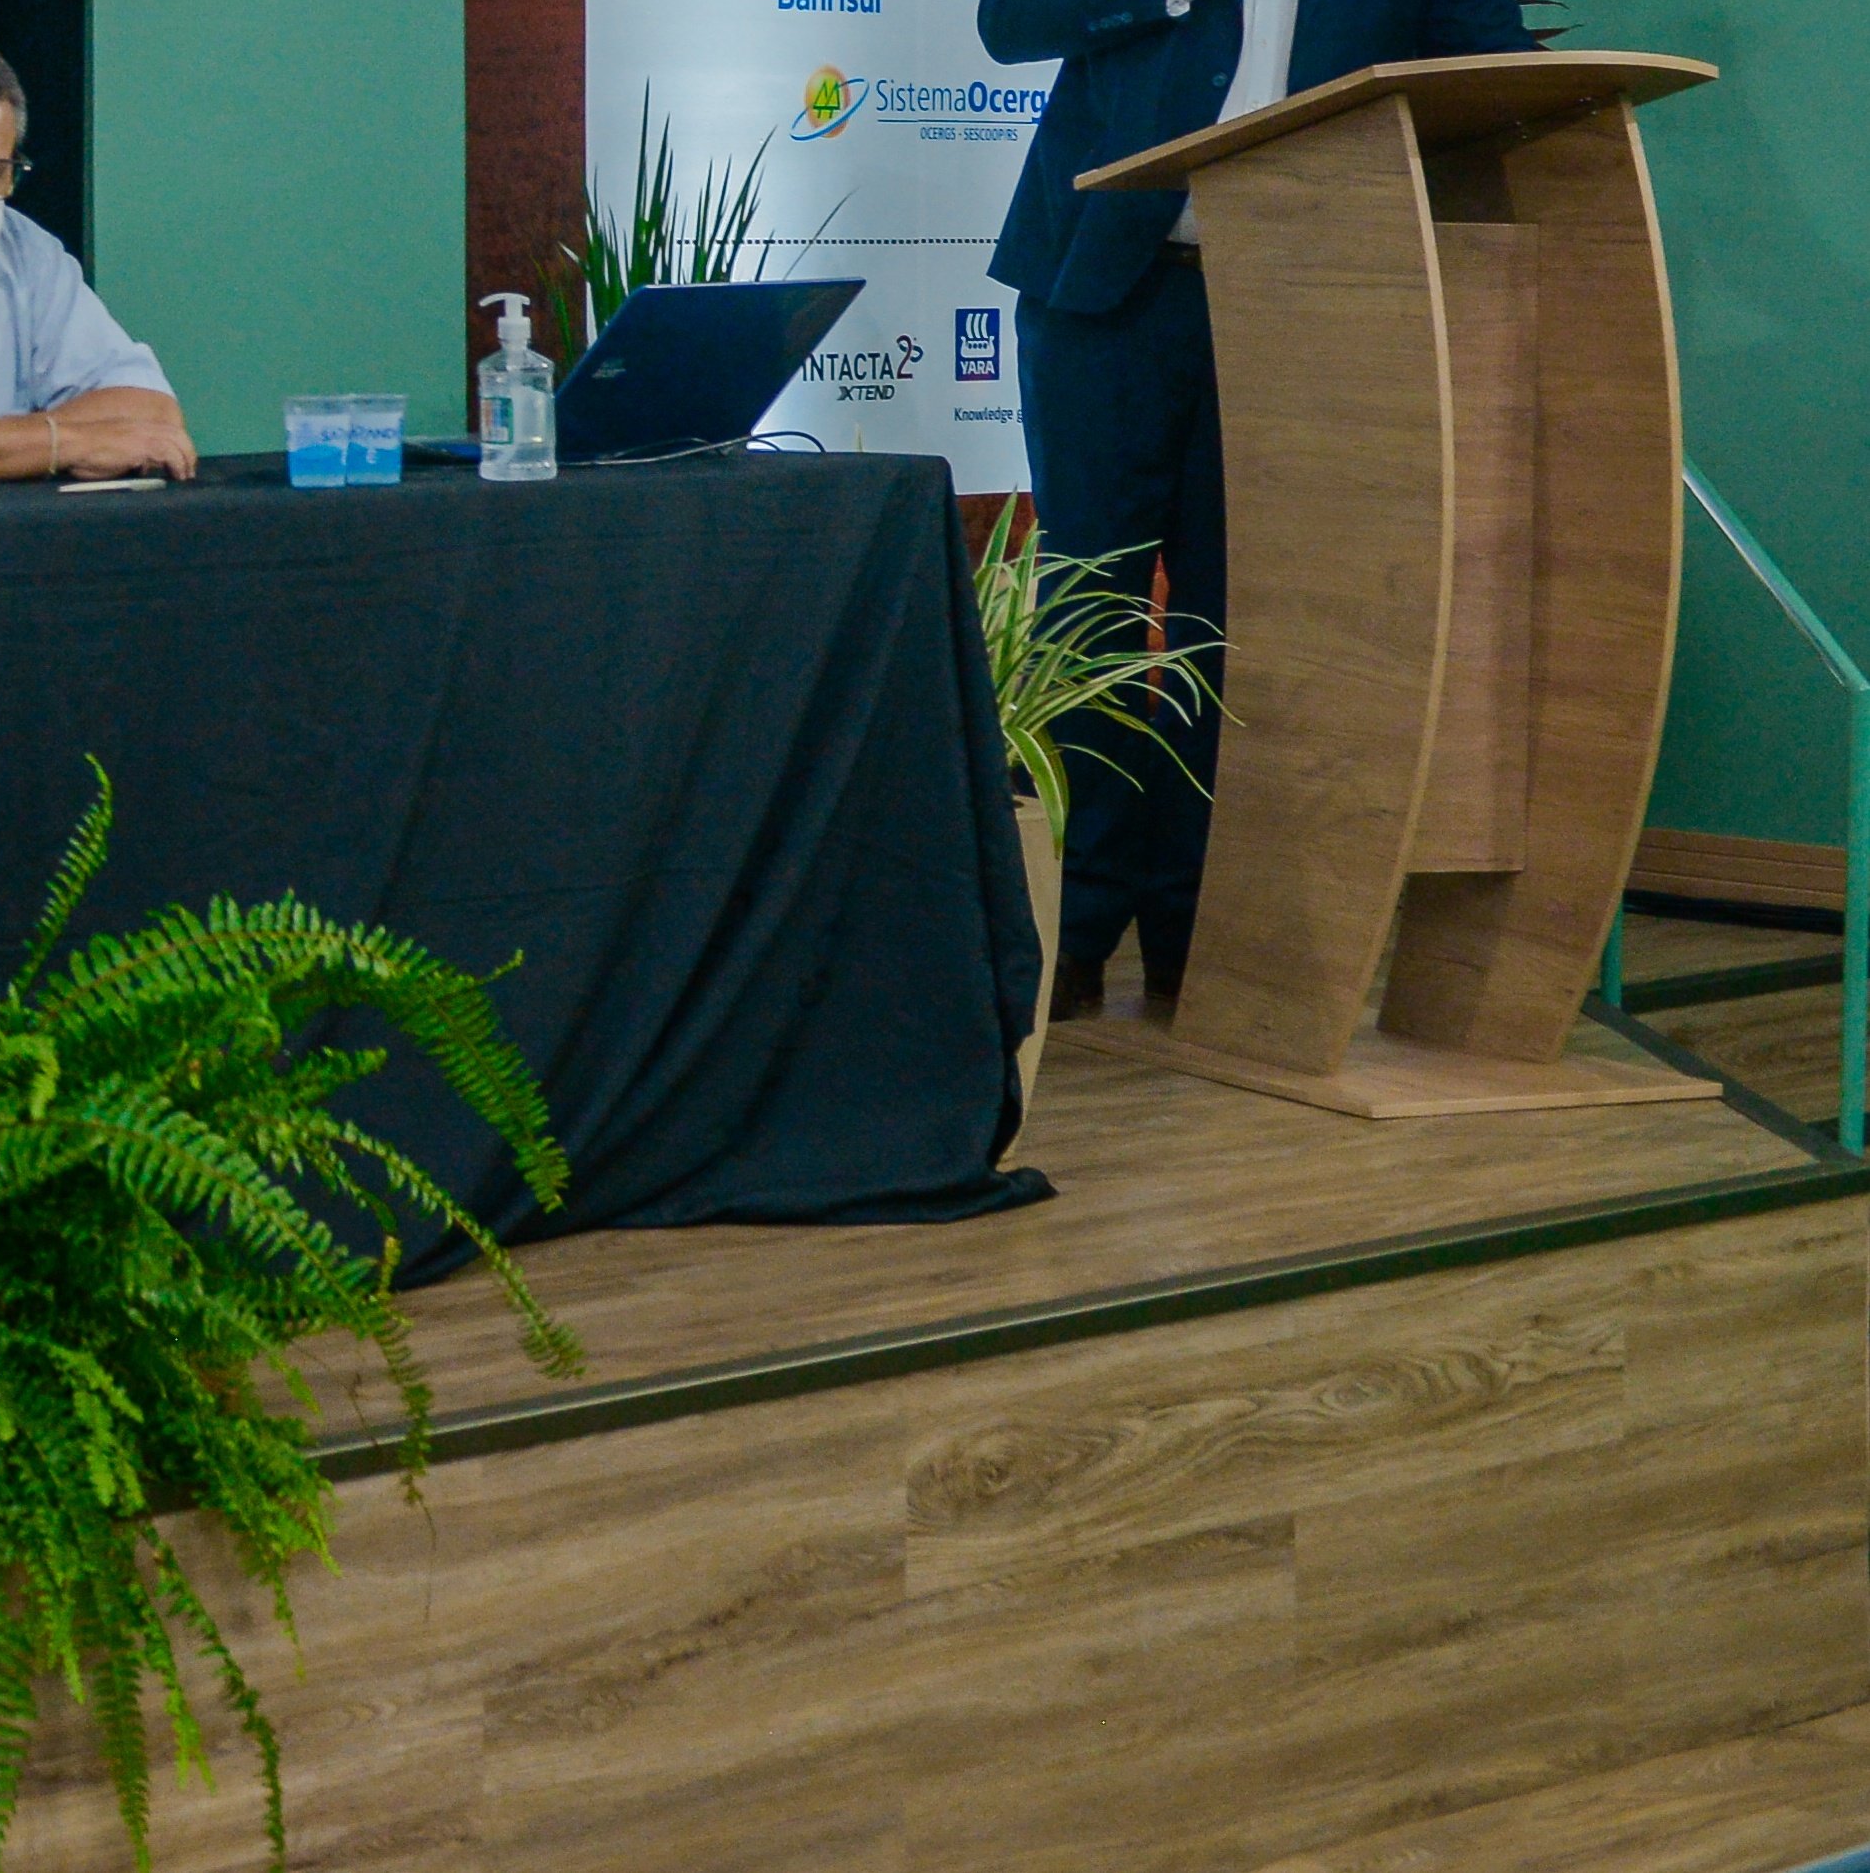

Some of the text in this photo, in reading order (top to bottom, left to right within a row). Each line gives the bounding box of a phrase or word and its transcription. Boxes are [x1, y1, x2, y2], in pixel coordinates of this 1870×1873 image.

[876, 79, 1048, 123] SistemaOcerg
[960, 360, 995, 375] YARA
[954, 407, 1013, 424] Knowledge
